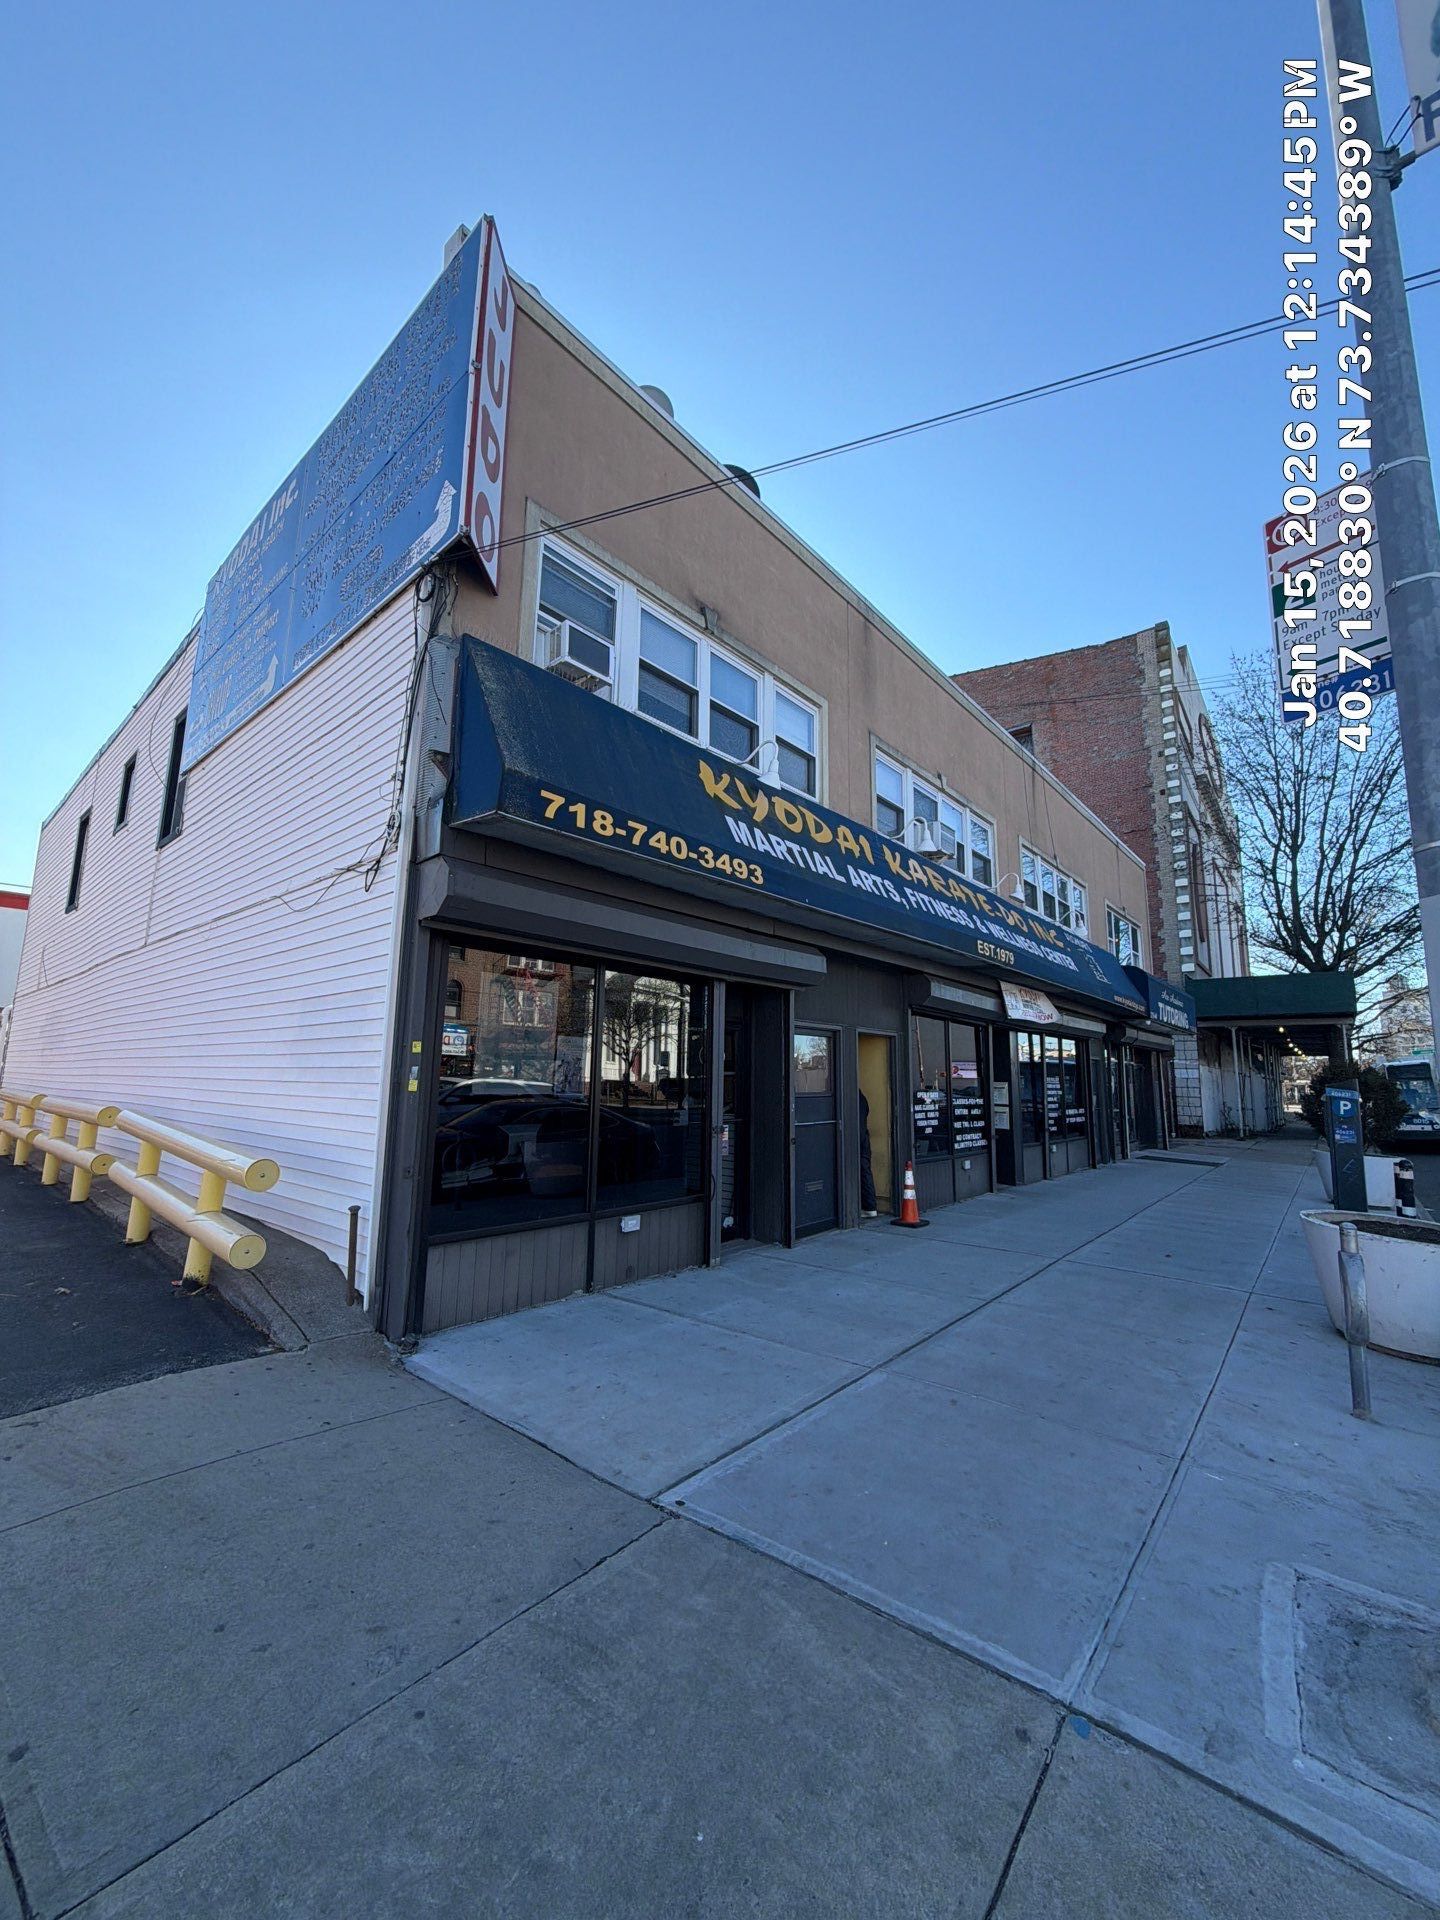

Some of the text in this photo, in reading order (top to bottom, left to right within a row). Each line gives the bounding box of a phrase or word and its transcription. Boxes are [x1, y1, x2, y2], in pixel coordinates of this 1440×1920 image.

[1283, 625, 1327, 651] Except
[1308, 670, 1391, 709] 06231
[541, 789, 764, 885] 718-740-3493
[698, 759, 875, 865] KYODAI
[882, 844, 1029, 933] KARATE-DO
[725, 815, 847, 884] MARTIAL
[847, 864, 909, 911] ARTS,
[904, 887, 975, 929] FITNESS
[972, 914, 989, 934] &
[983, 919, 1044, 958] WELLNESS
[1040, 945, 1079, 972] CENTER
[1158, 1001, 1189, 1030] TUTORING
[1340, 1100, 1352, 1115] P
